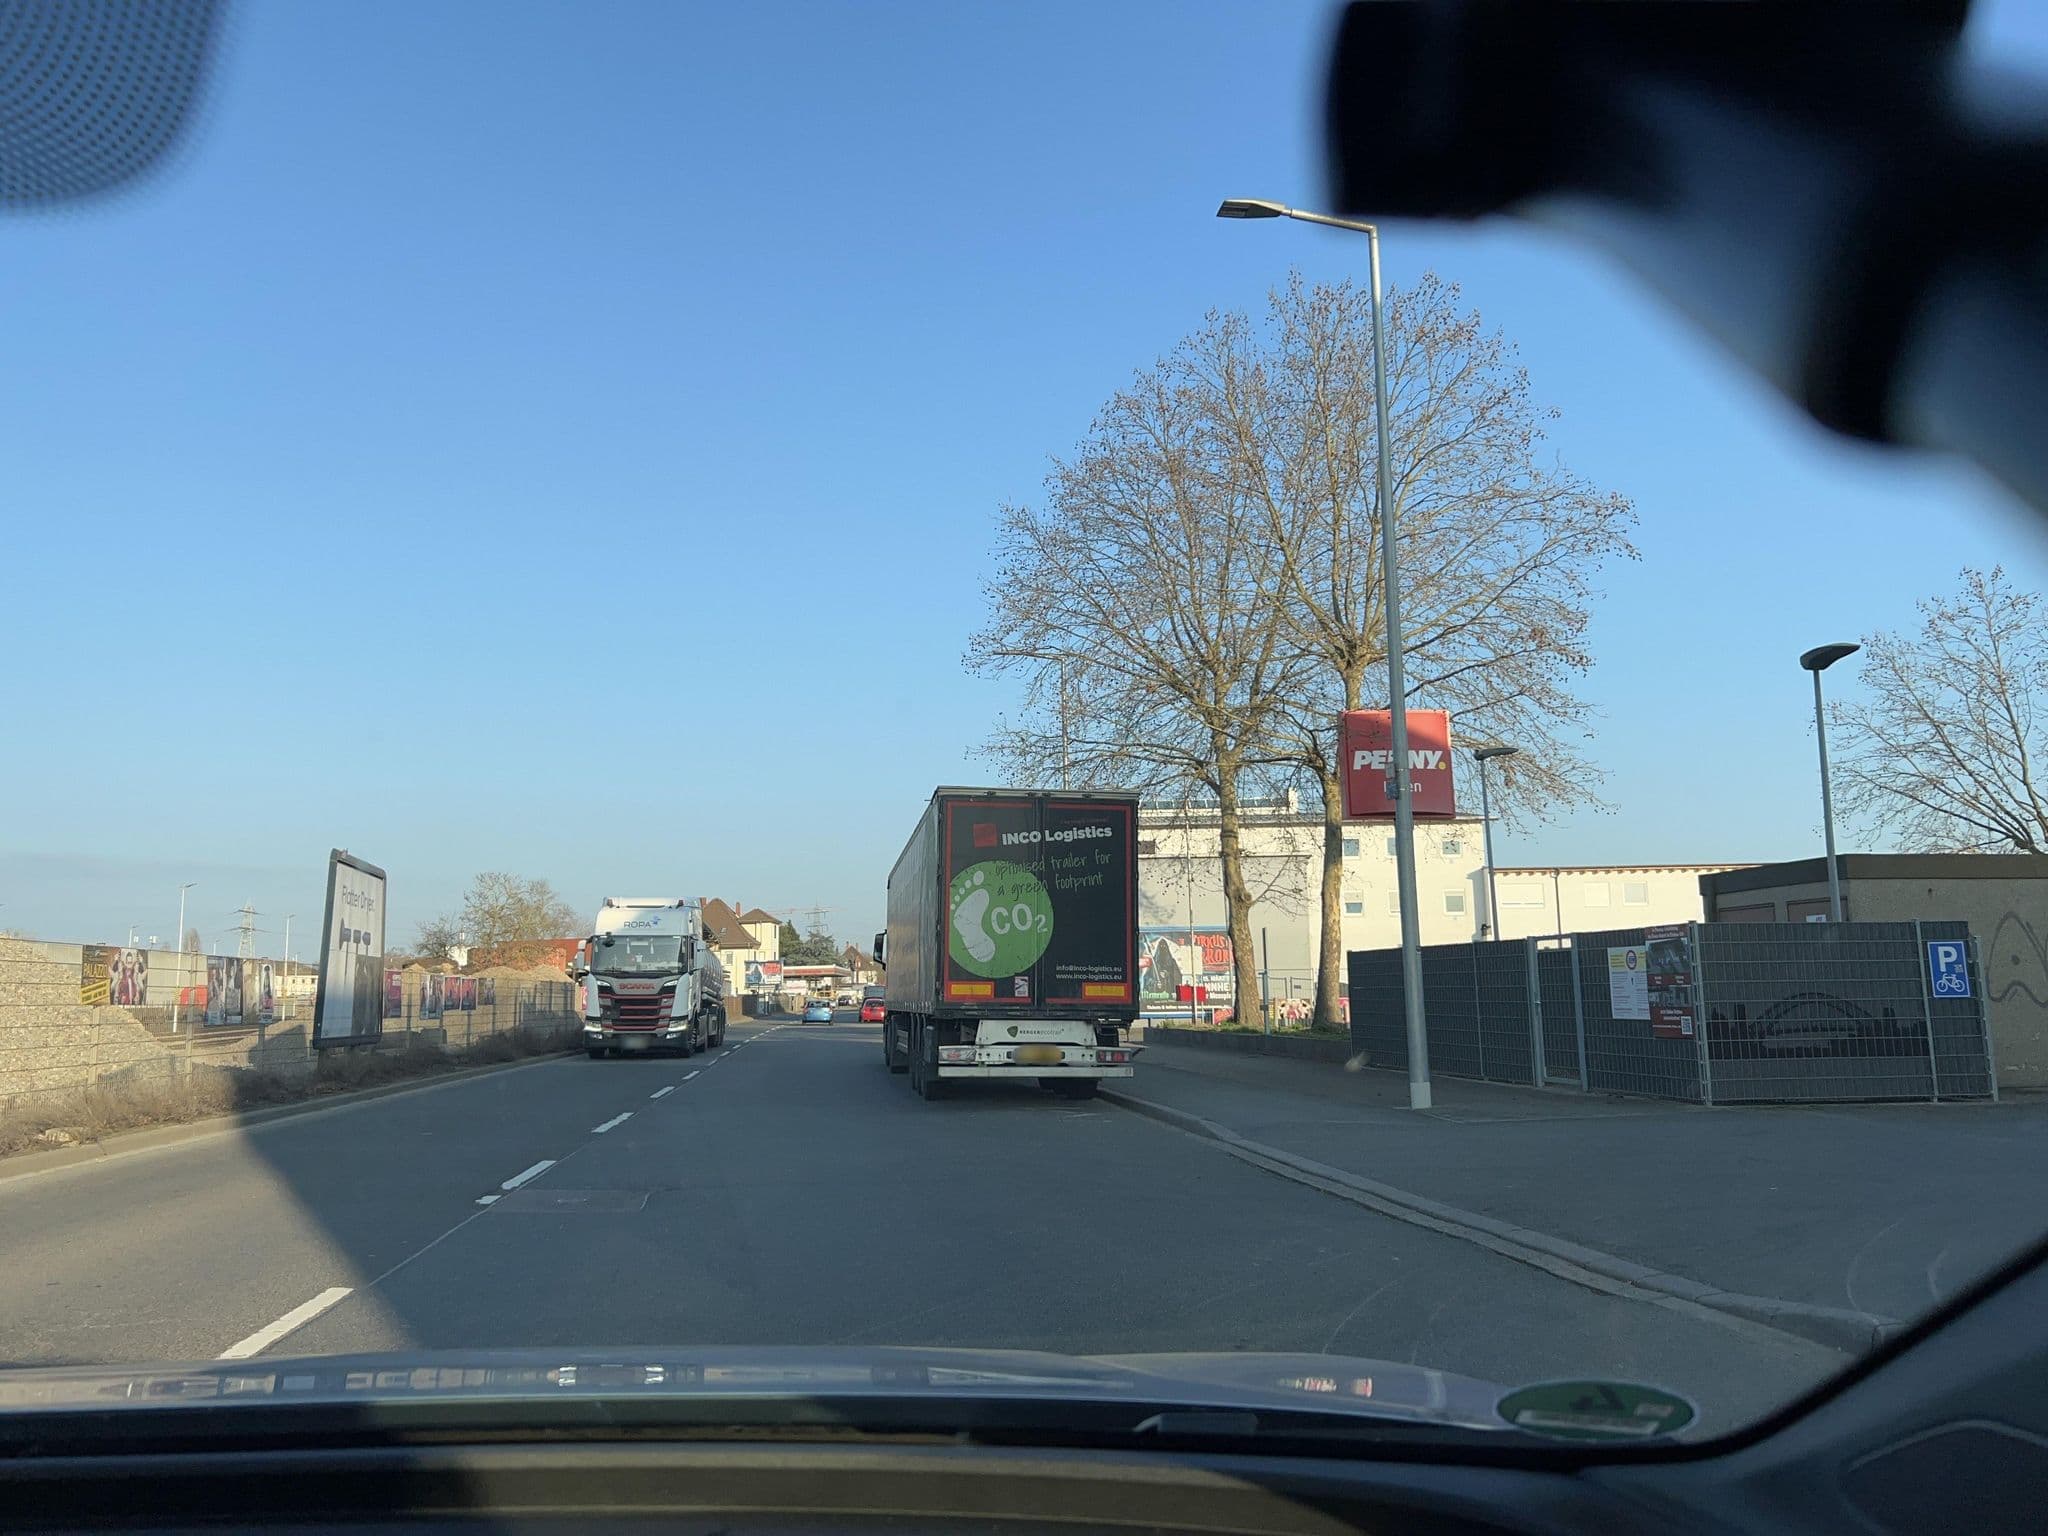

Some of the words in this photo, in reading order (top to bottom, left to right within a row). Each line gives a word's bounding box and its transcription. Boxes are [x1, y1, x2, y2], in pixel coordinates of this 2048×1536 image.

[1353, 750, 1446, 770] PENY.
[1002, 831, 1041, 845] INCO
[1045, 826, 1112, 842] Logistics
[1051, 852, 1087, 870] trailer
[1094, 849, 1112, 864] for
[1012, 880, 1048, 901] green
[1056, 872, 1103, 892] footprint
[1056, 965, 1122, 973] info@inco-logistics.eu
[1938, 946, 1958, 972] P
